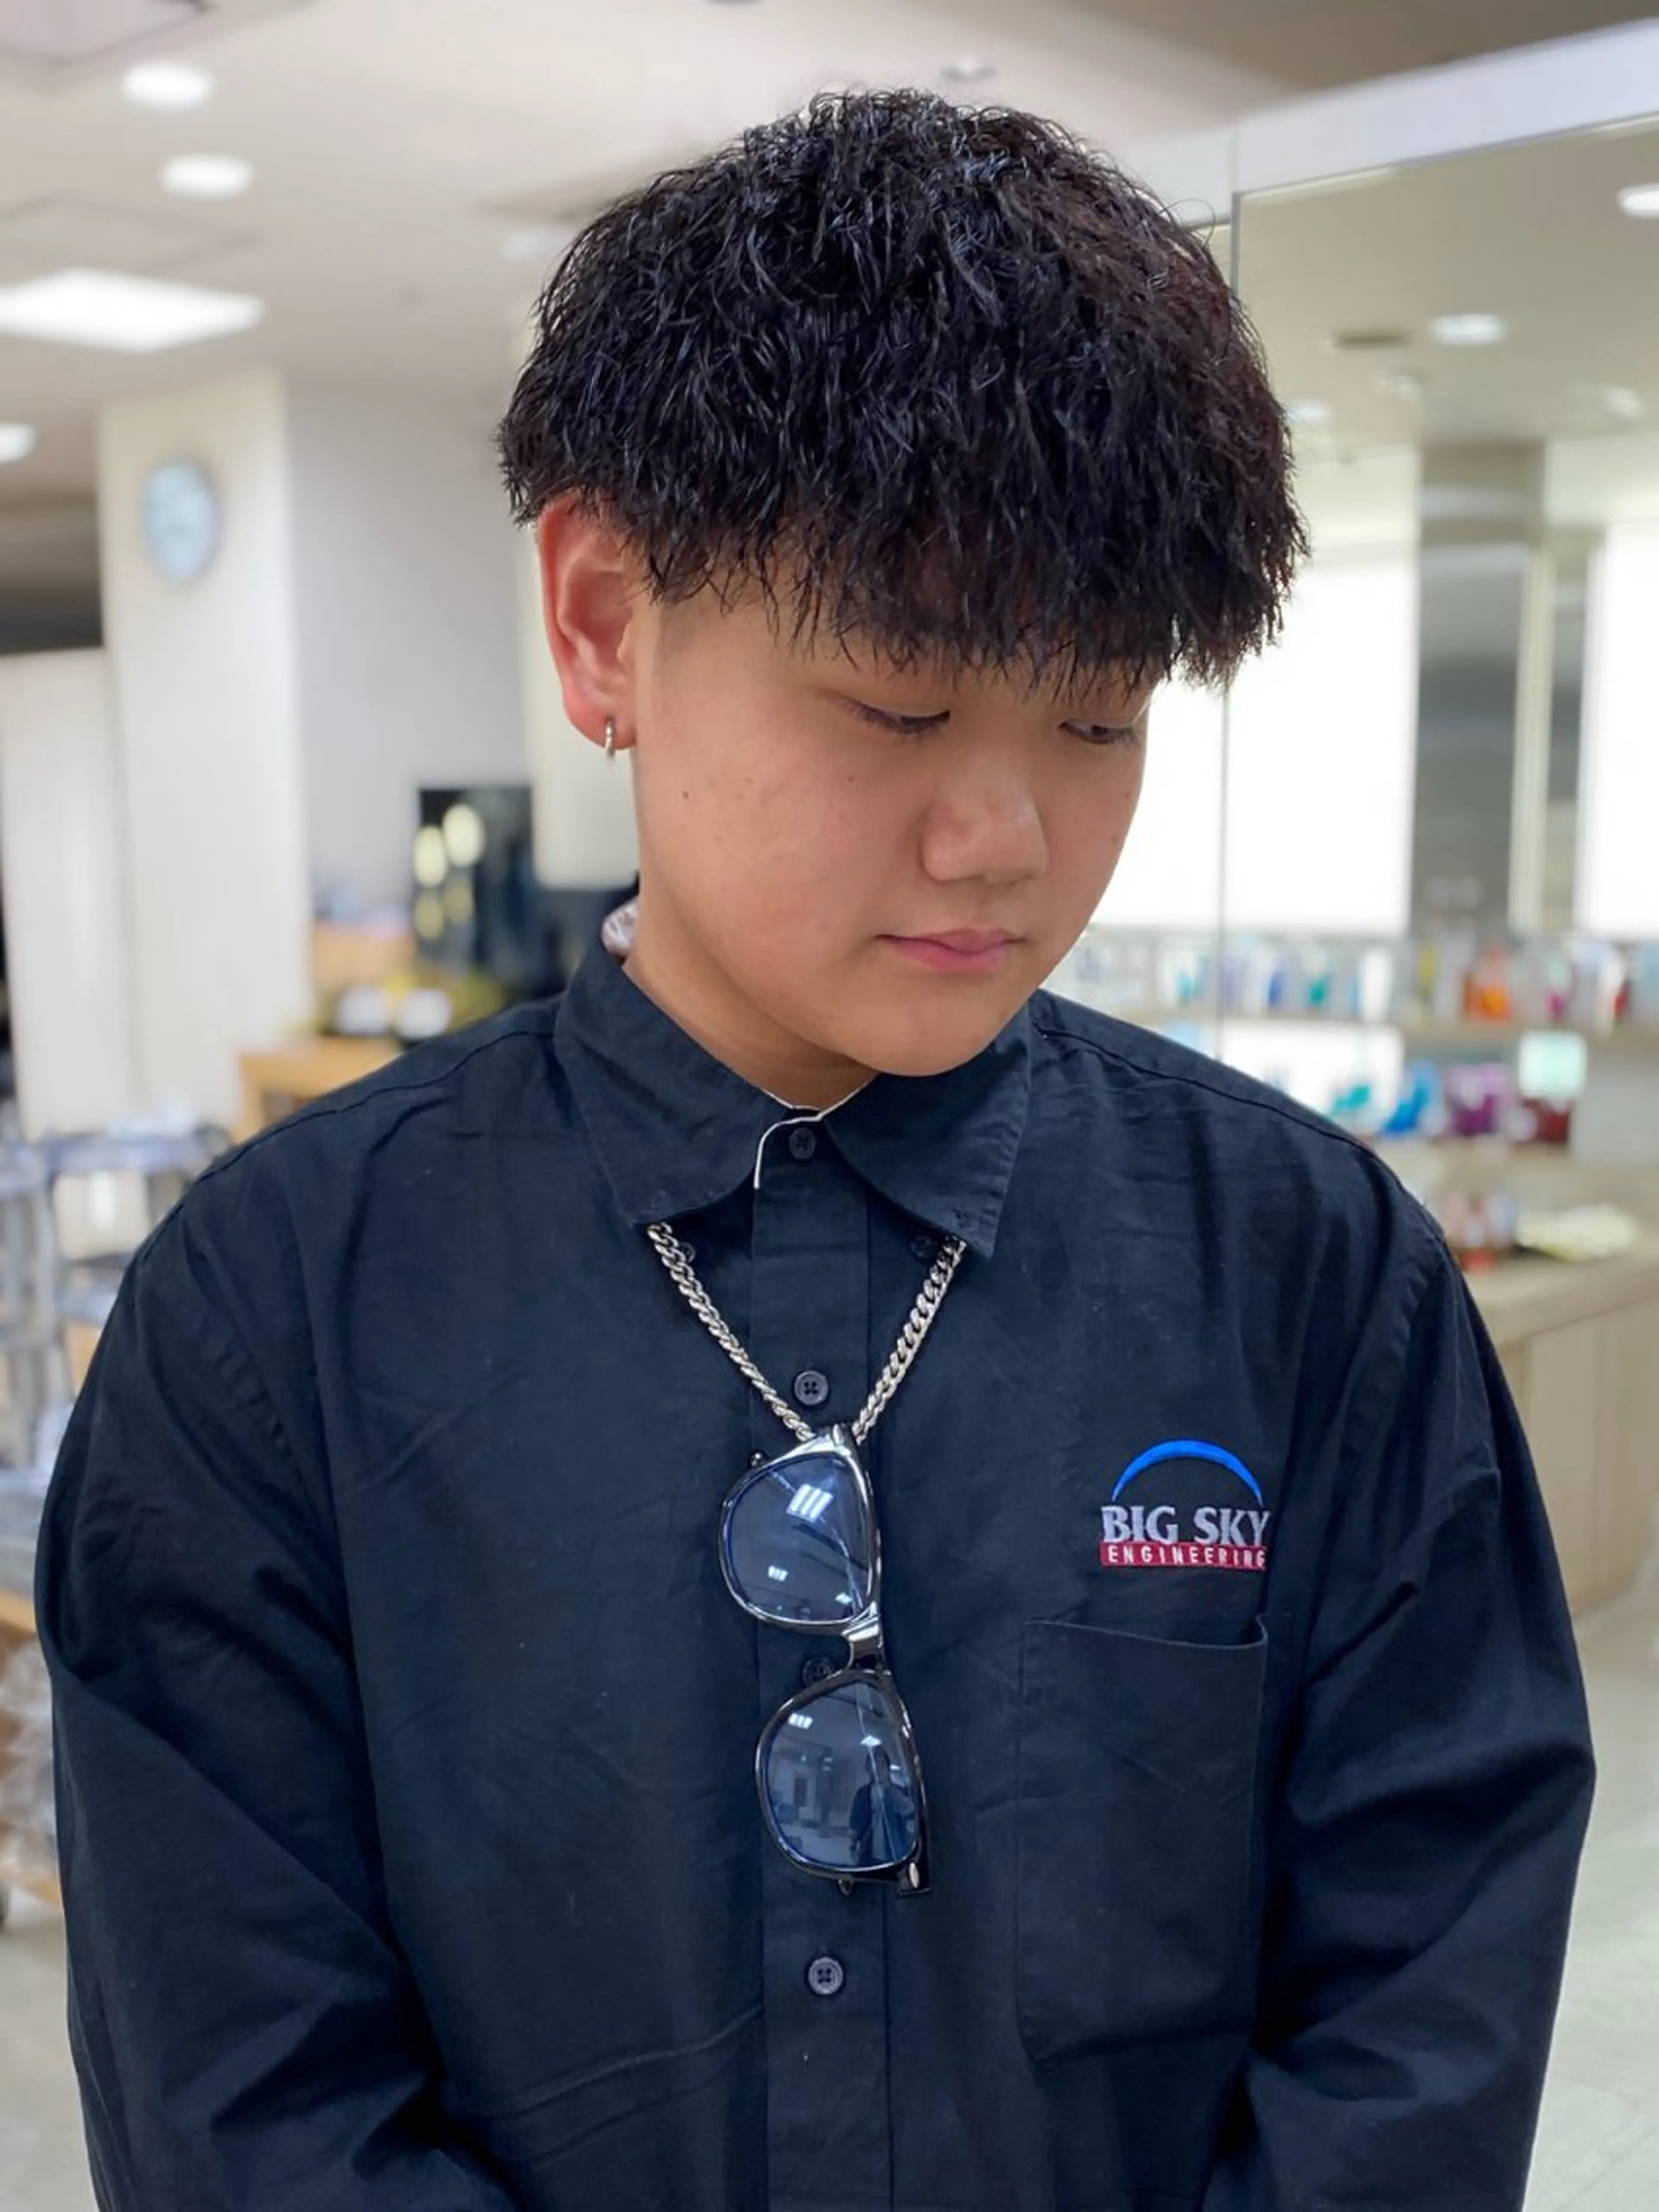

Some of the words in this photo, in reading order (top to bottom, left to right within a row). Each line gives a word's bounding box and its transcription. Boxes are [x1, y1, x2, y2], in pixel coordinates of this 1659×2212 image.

[1101, 1505, 1179, 1545] BIG
[1193, 1507, 1271, 1547] SKY
[1107, 1545, 1266, 1567] ENGINEERING
